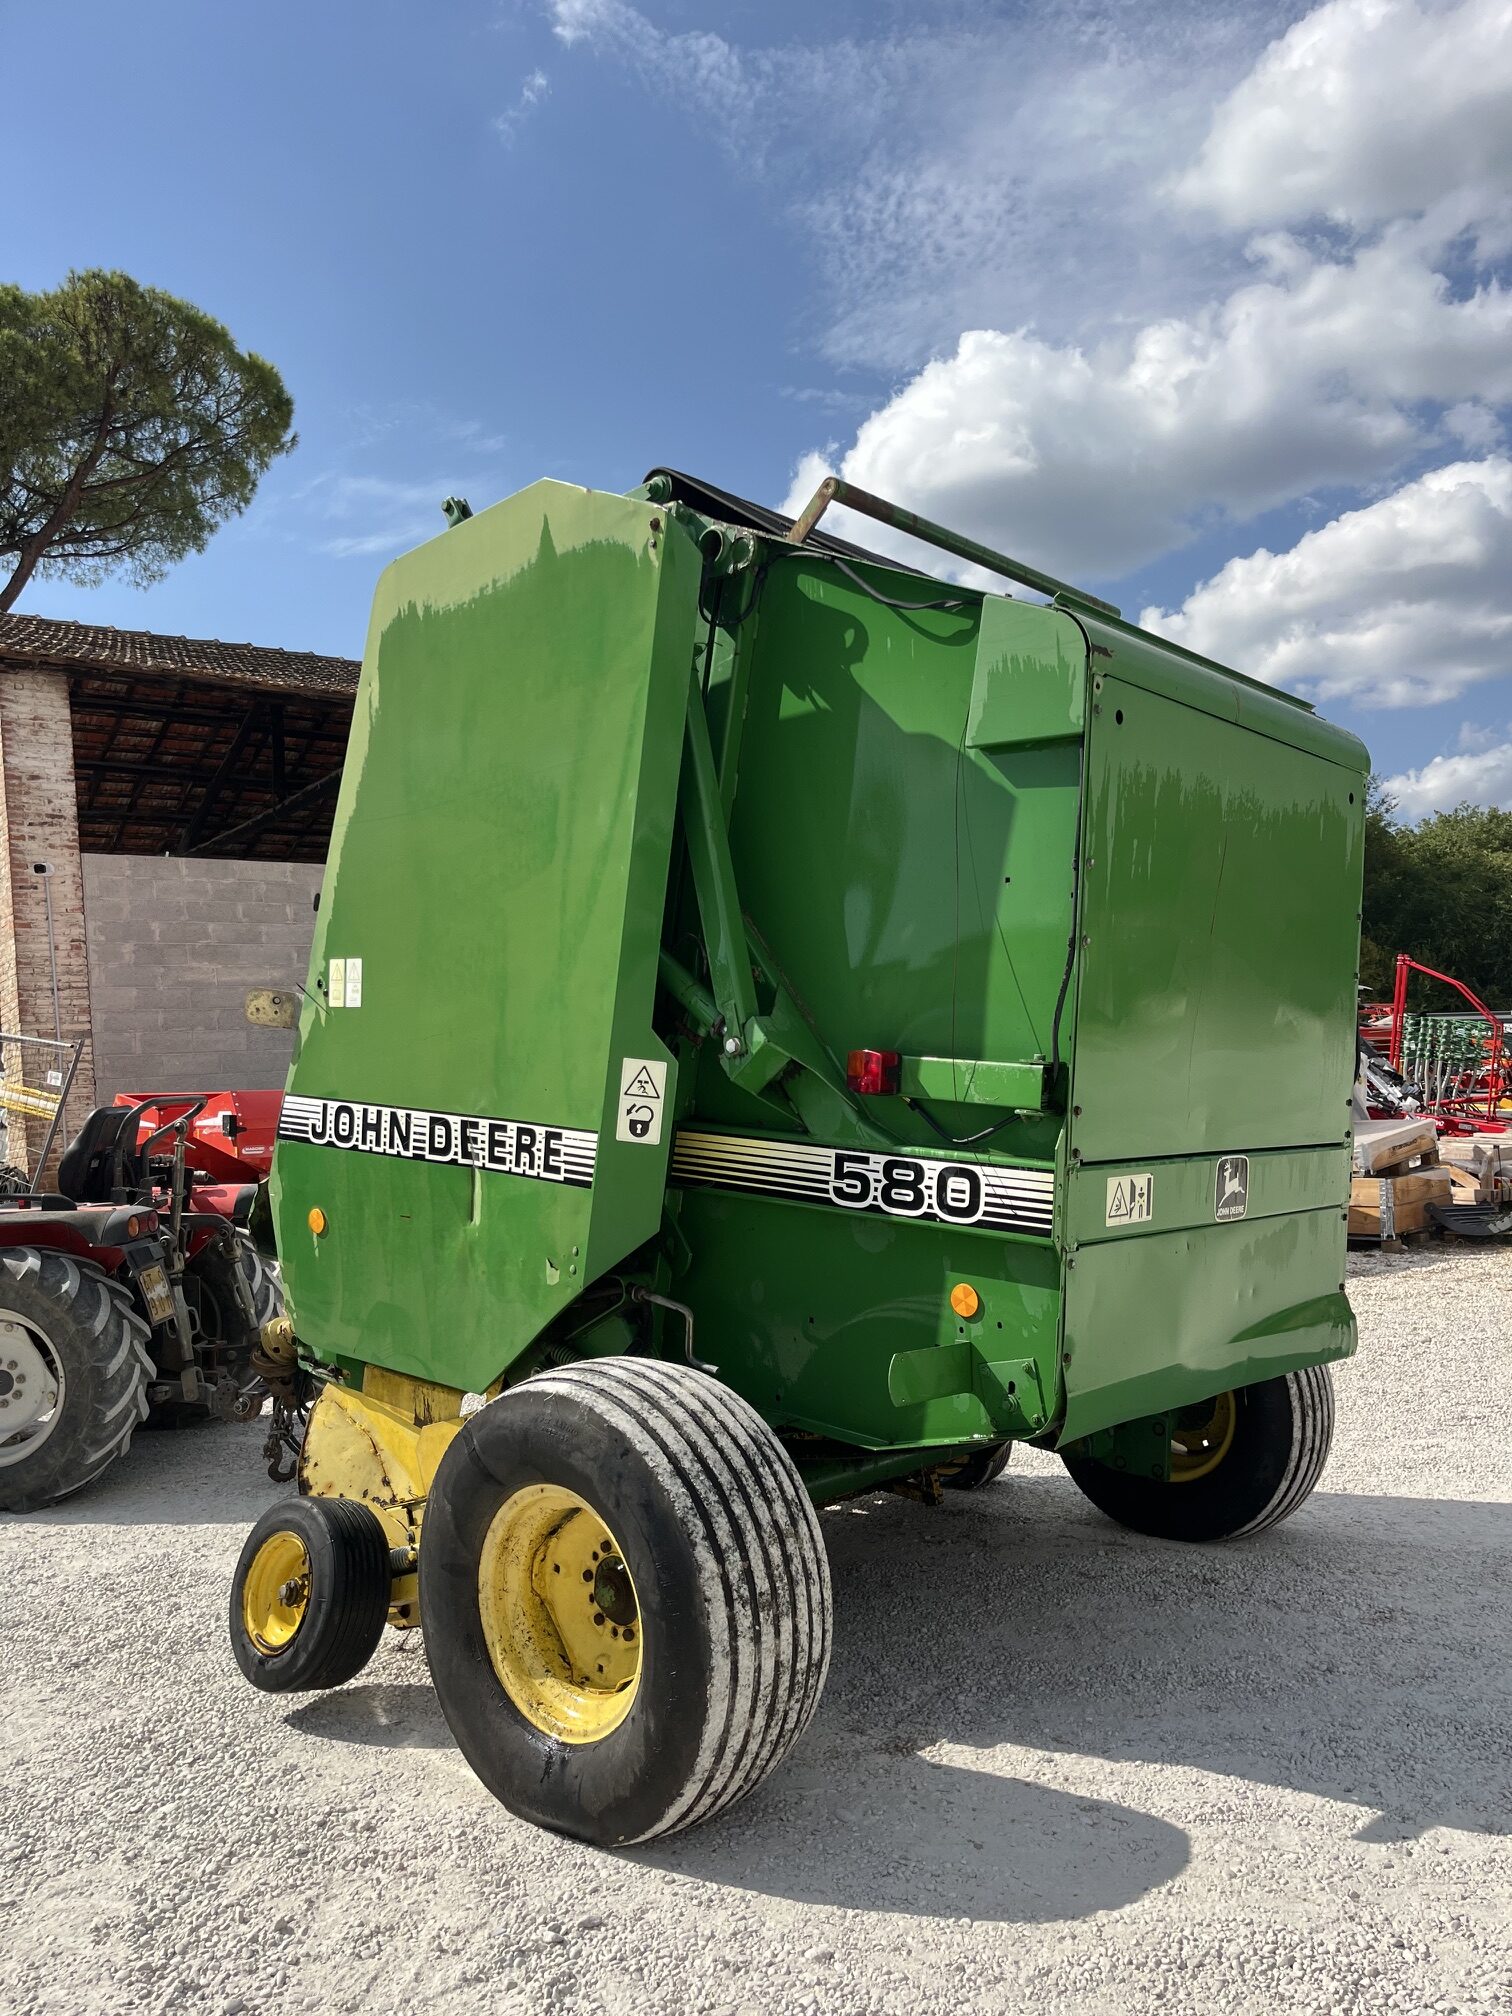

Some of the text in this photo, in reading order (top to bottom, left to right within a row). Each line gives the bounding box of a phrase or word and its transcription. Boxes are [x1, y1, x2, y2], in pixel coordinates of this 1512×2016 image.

[310, 1102, 565, 1181] JOHN DEERE
[830, 1152, 984, 1223] 580
[1217, 1205, 1244, 1216] JOHN DEERE
